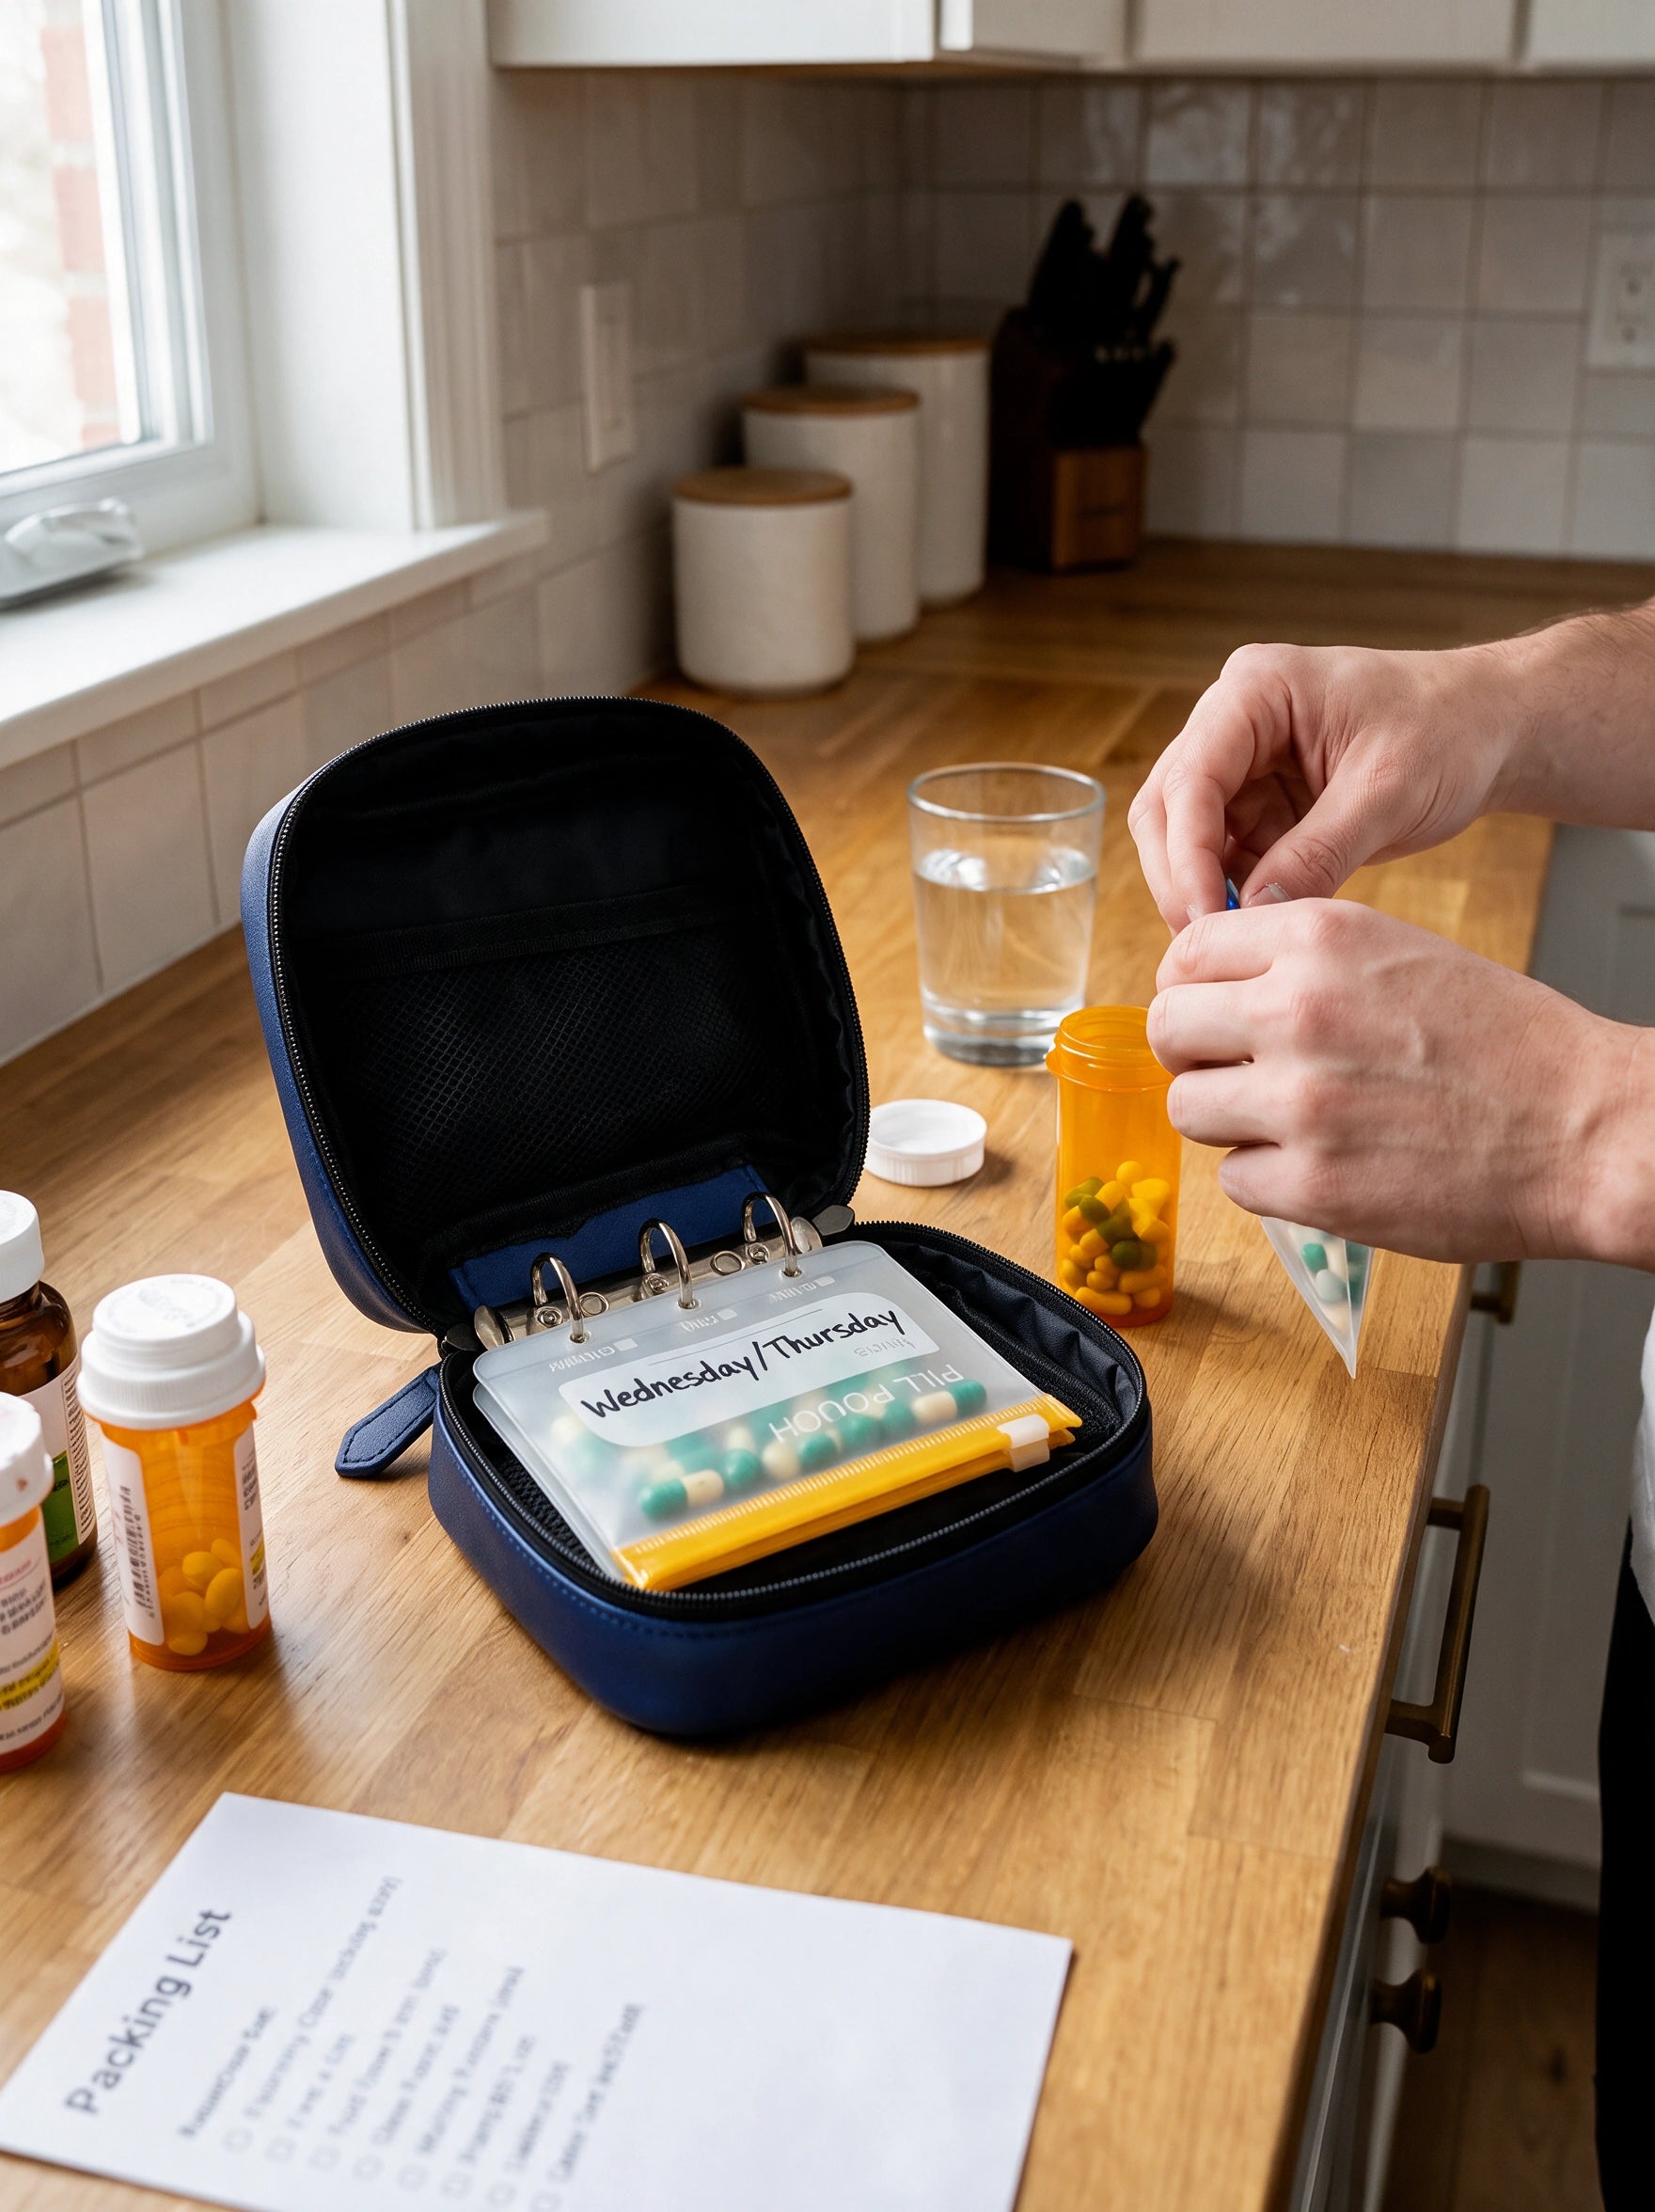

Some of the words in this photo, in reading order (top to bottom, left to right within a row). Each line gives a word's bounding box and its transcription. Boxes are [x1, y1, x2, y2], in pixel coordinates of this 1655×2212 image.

[580, 1309, 906, 1418] Wednesday/Thursday
[892, 1364, 965, 1393] PILL
[63, 1974, 192, 2117] Packing
[166, 1909, 232, 1967] List
